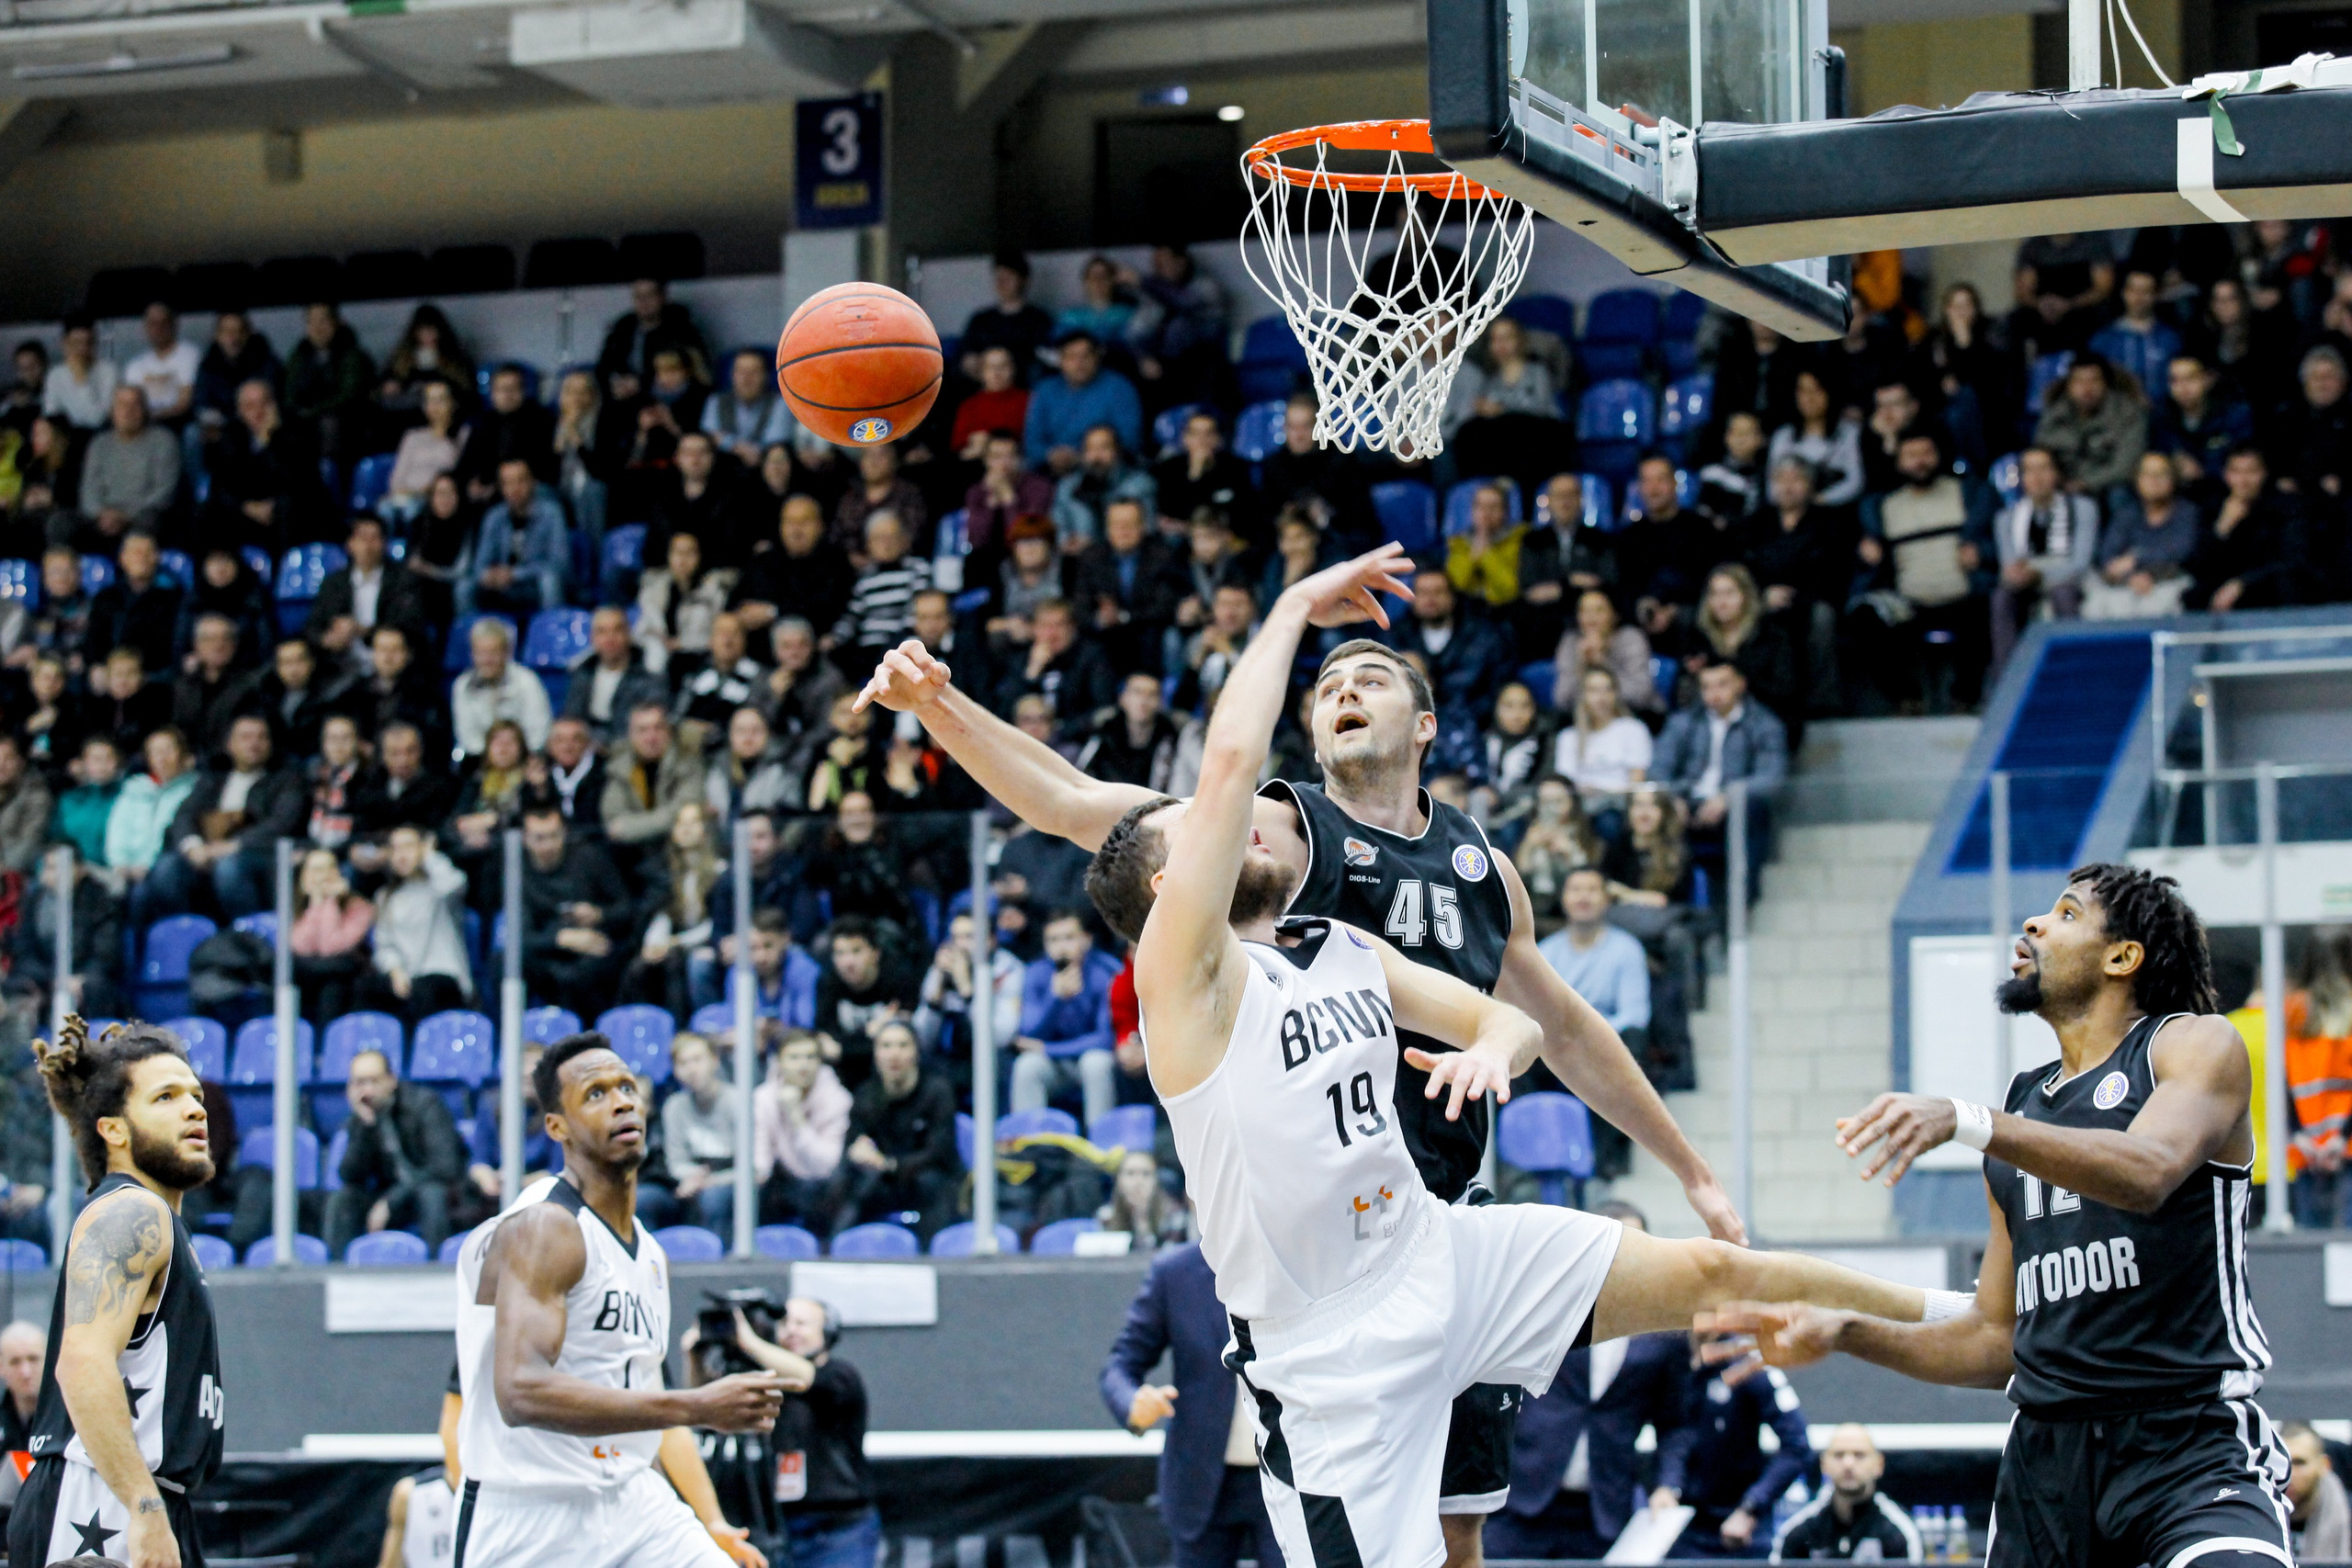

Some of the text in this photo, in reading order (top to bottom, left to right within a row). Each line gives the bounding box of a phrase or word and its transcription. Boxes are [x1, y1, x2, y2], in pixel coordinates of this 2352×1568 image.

[821, 107, 861, 175] 3
[1349, 874, 1381, 885] DIGS-Line
[1385, 879, 1464, 950] 45
[1326, 1071, 1387, 1147] 19
